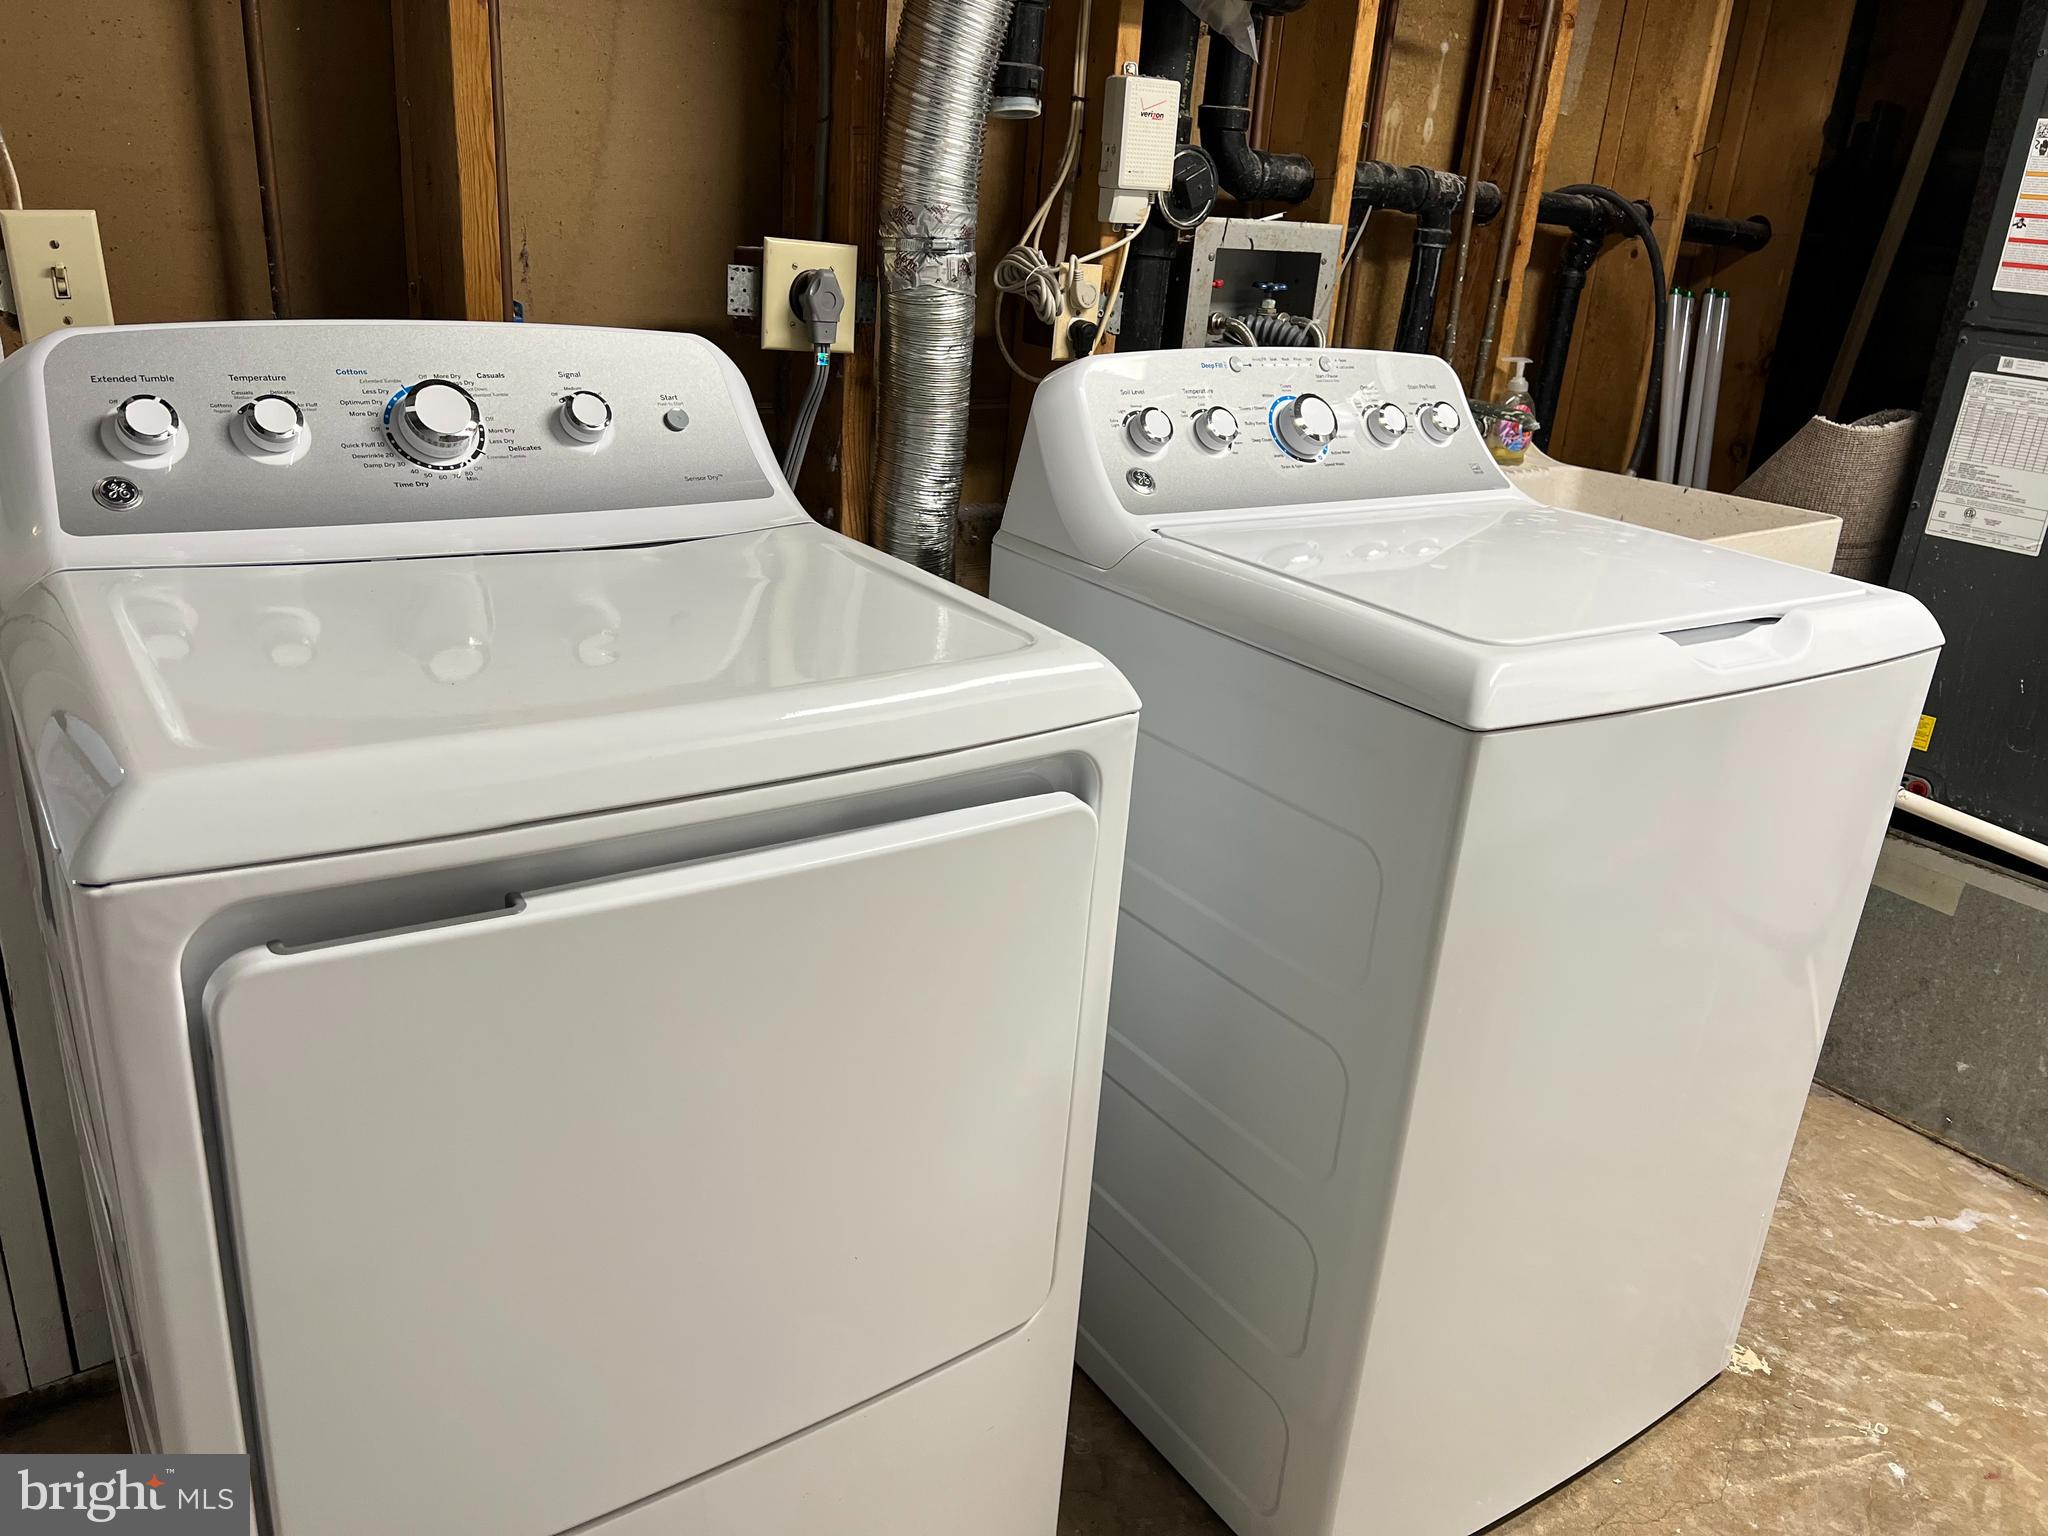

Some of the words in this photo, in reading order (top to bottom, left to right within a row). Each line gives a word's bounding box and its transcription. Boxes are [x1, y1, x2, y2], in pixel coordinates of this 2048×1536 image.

[1140, 111, 1164, 120] verizon
[335, 368, 368, 376] Cottons
[476, 372, 506, 380] Casuals
[557, 371, 581, 379] Signal
[90, 375, 138, 383] Extended
[138, 374, 175, 383] Tumble
[228, 374, 287, 383] Temperature
[463, 379, 475, 387] Dry
[377, 388, 389, 396] Dry
[351, 452, 384, 460] Dewrinkle
[383, 461, 396, 469] Dry
